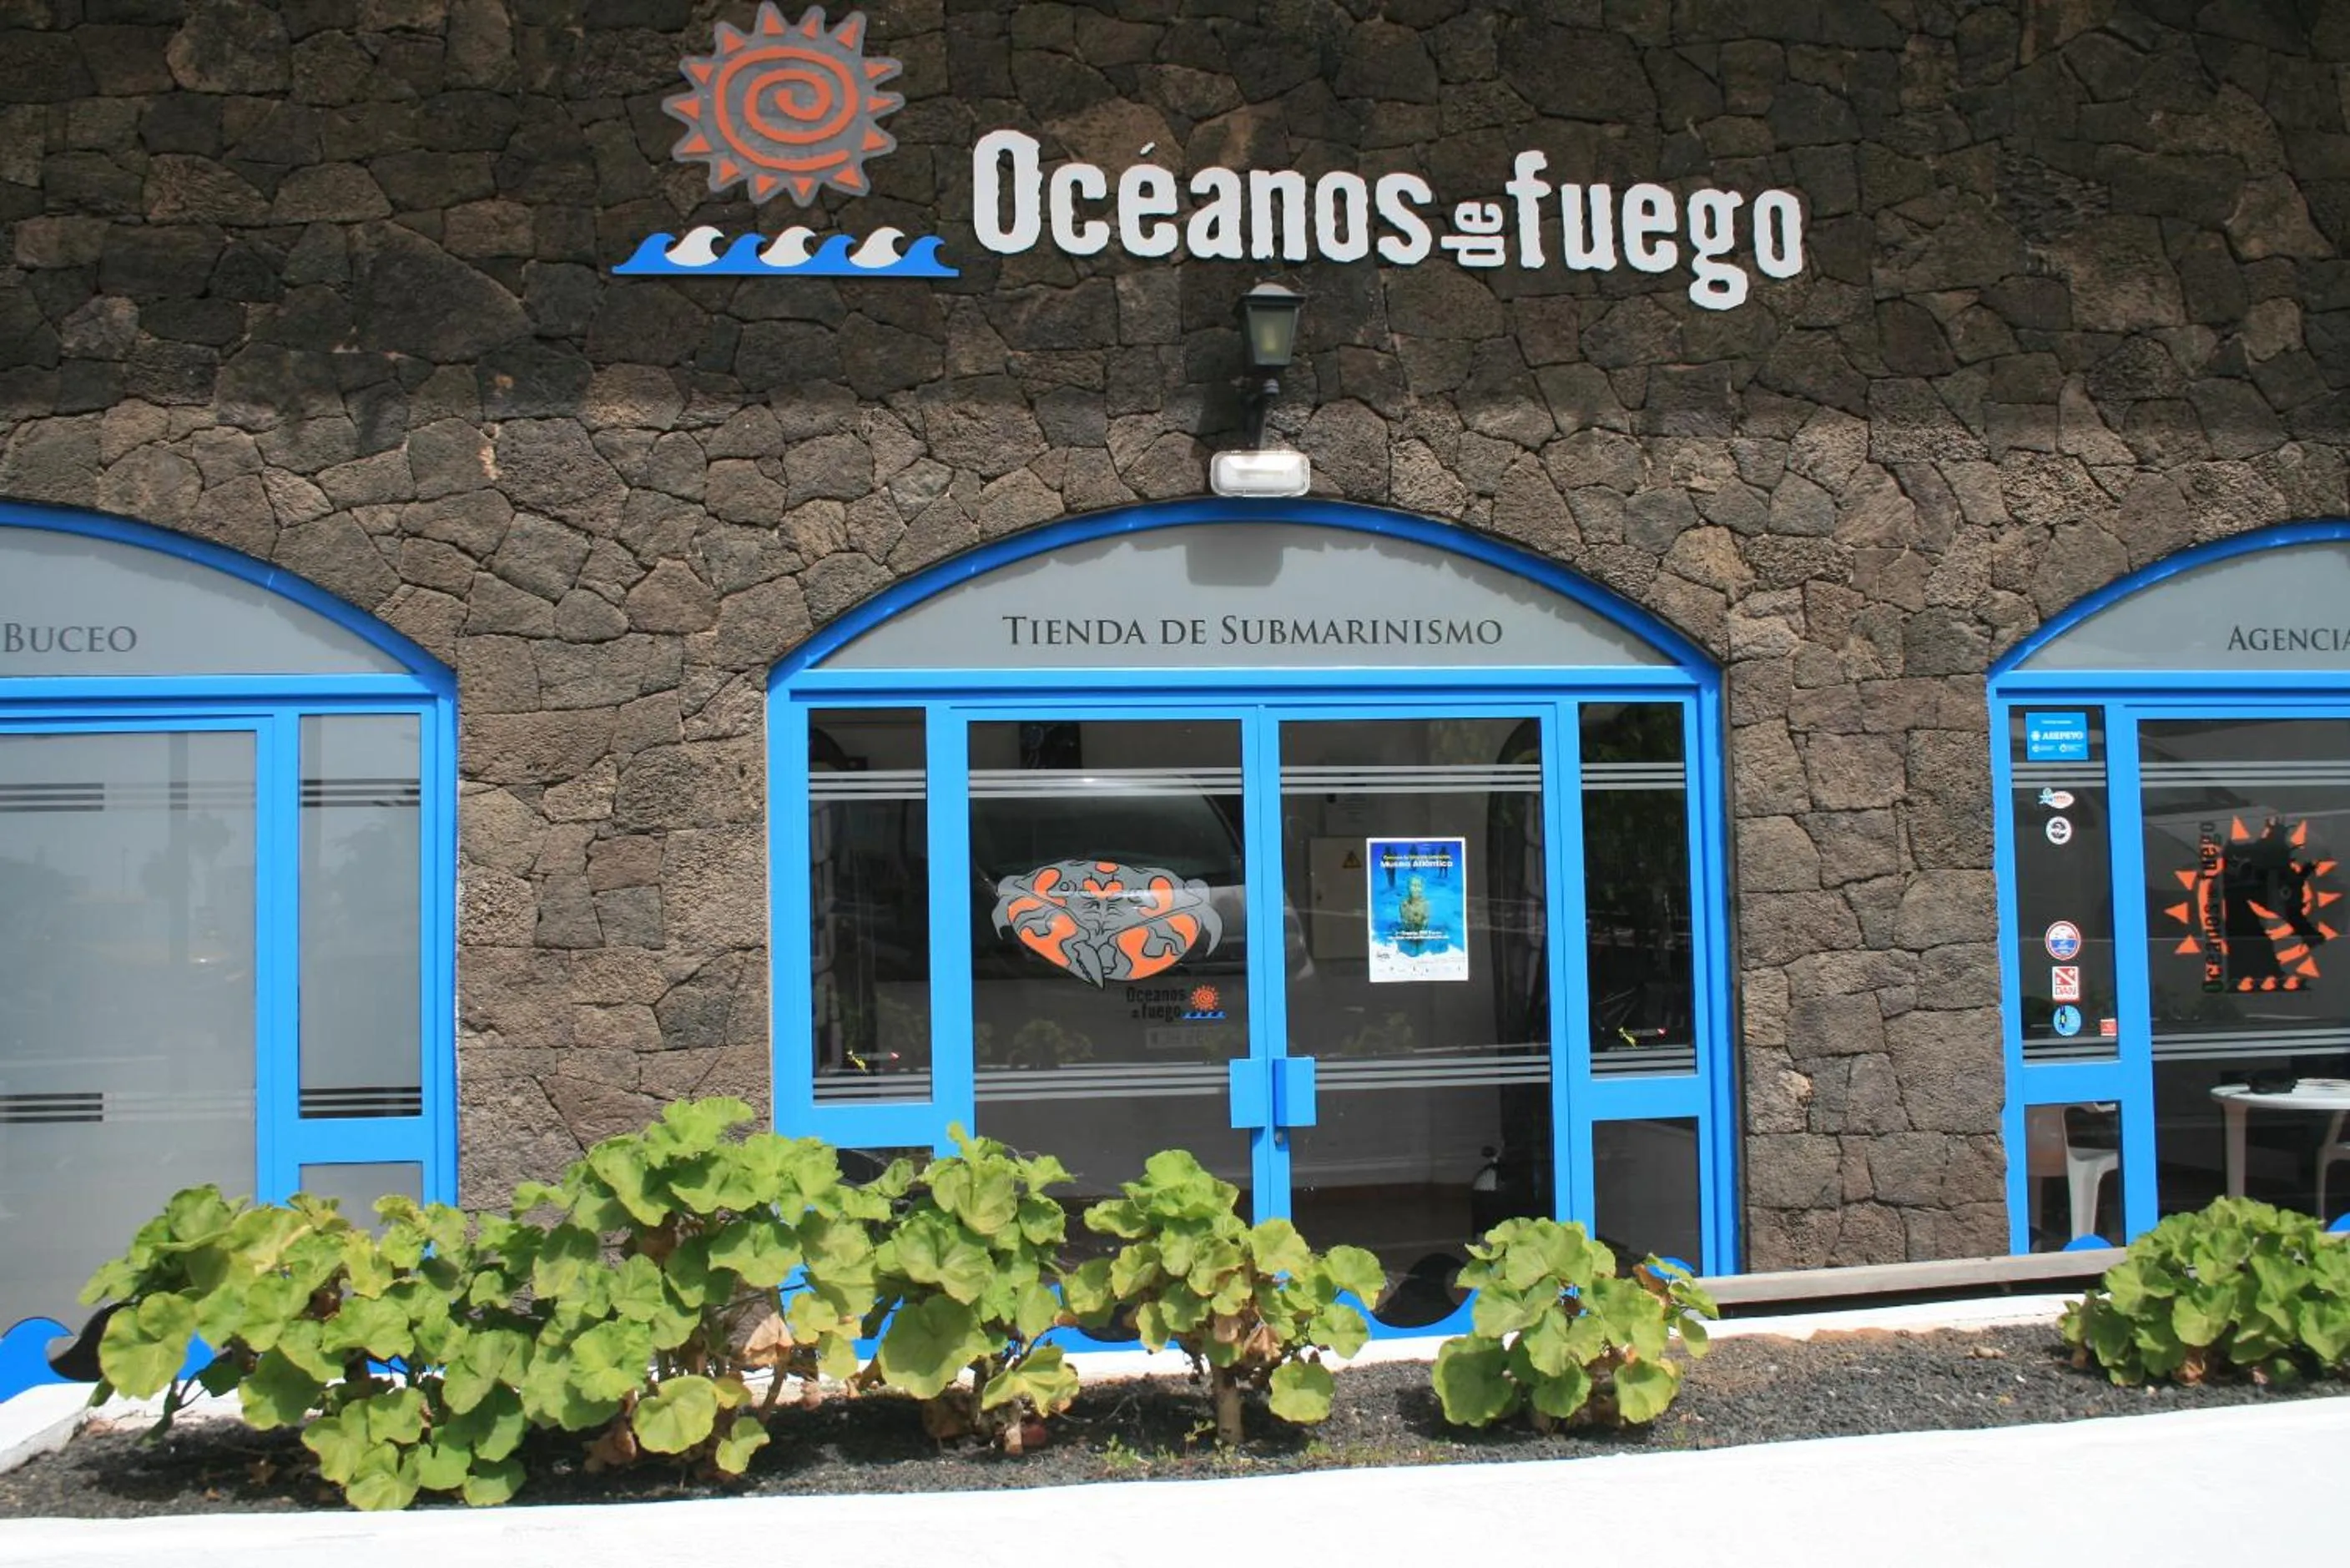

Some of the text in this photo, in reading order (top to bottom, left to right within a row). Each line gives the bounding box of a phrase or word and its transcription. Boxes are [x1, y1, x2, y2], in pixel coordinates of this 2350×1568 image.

[972, 129, 1803, 310] Océanos de fuego
[3, 622, 138, 653] BUCEO
[1002, 615, 1503, 646] TIENDA DE SUBMARINISMO
[1142, 1004, 1182, 1022] fuego
